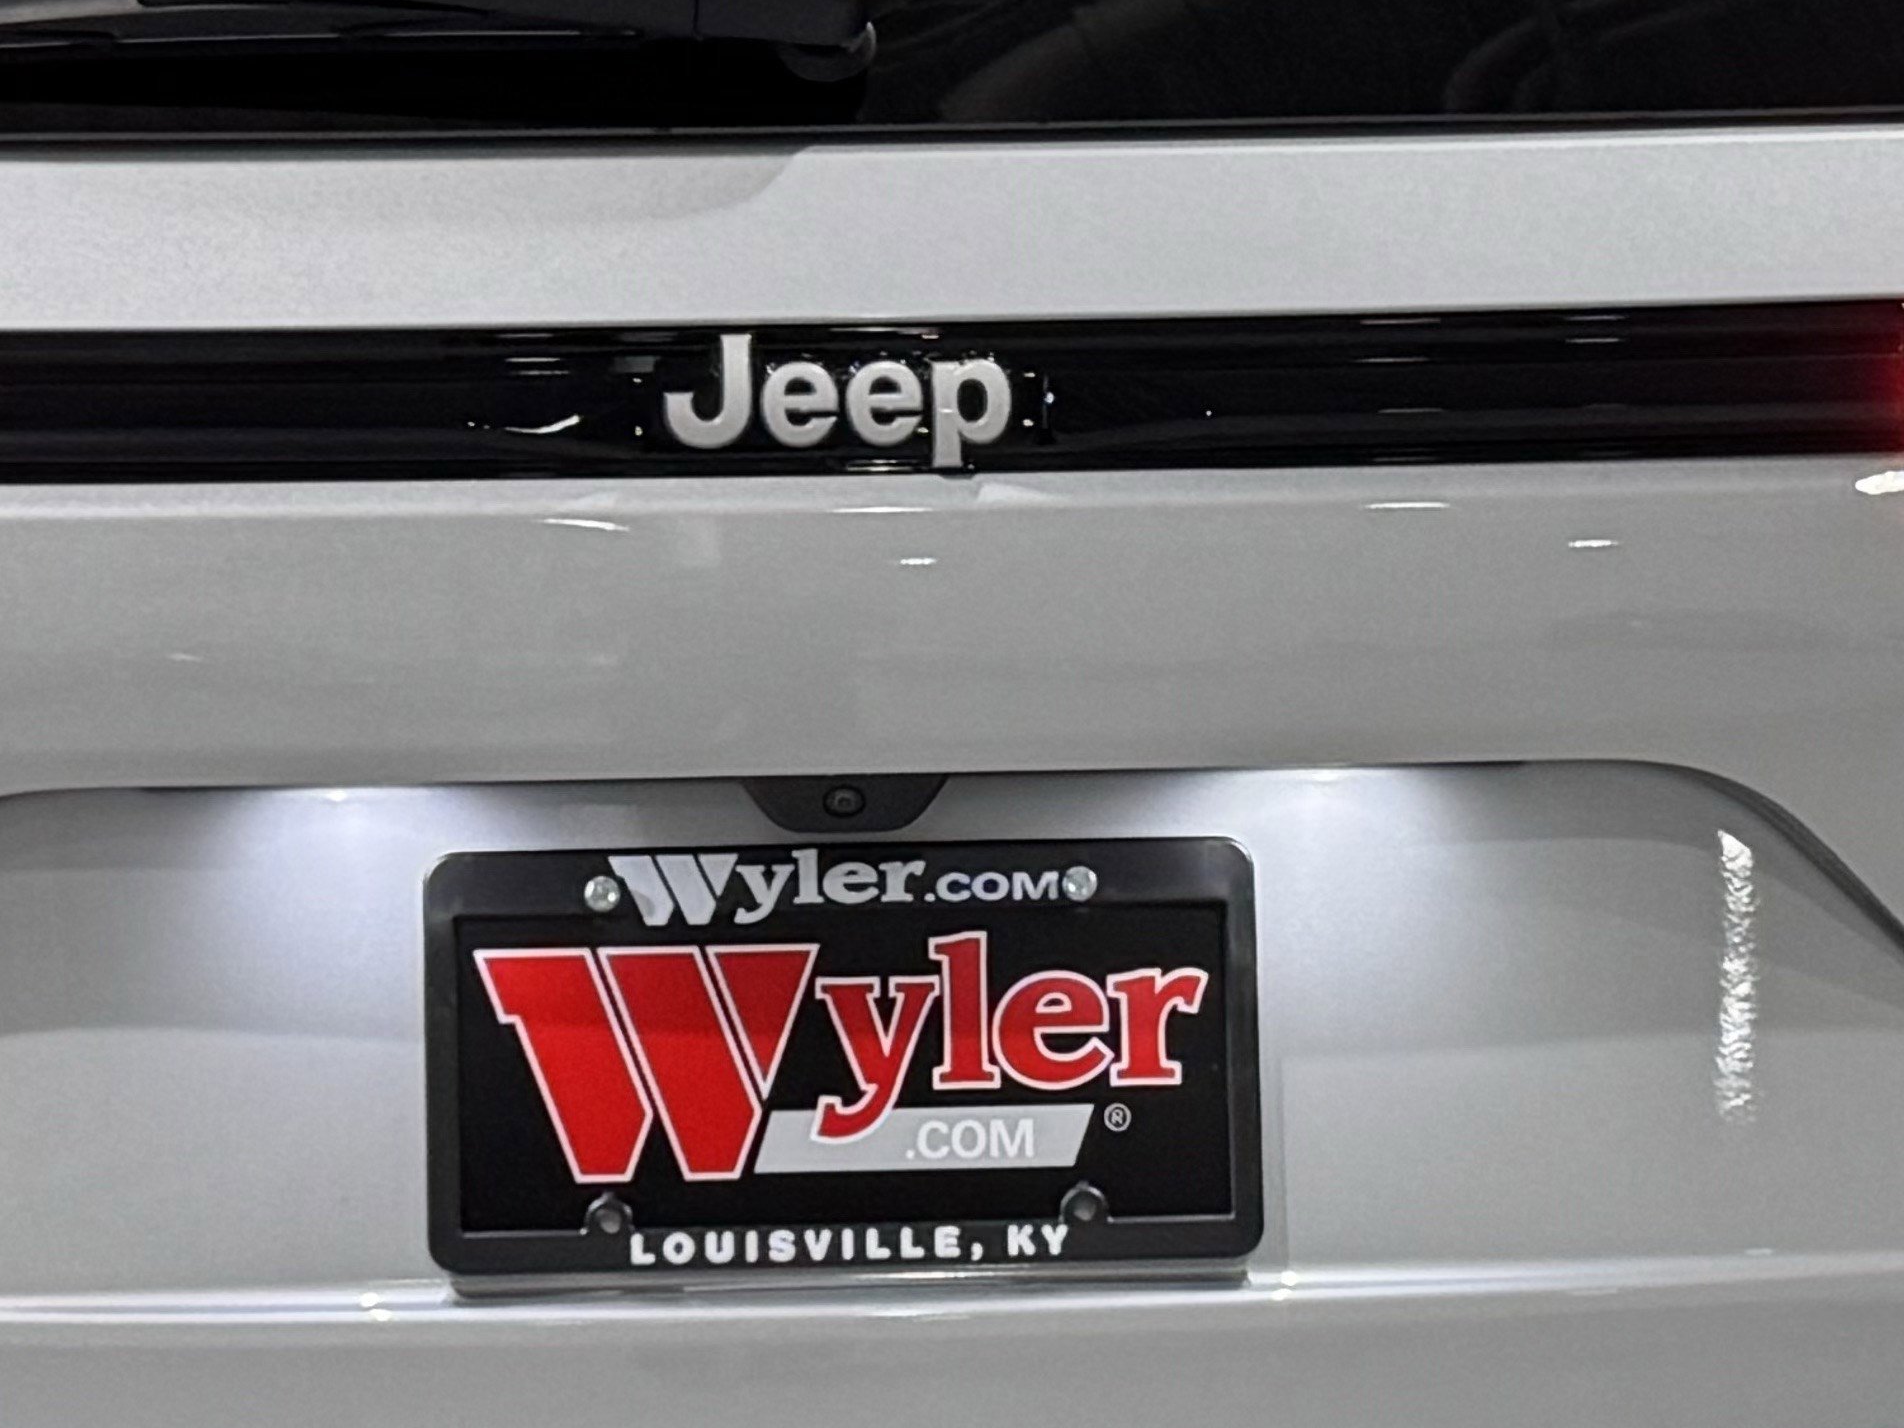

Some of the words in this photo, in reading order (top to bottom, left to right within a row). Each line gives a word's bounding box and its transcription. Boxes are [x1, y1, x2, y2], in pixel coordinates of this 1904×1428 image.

[663, 333, 1012, 469] Jeep
[472, 930, 1210, 1184] Wyler
[904, 1117, 1036, 1161] .COM
[629, 1225, 985, 1266] LOUISVILLE,
[1007, 1223, 1070, 1256] KY
